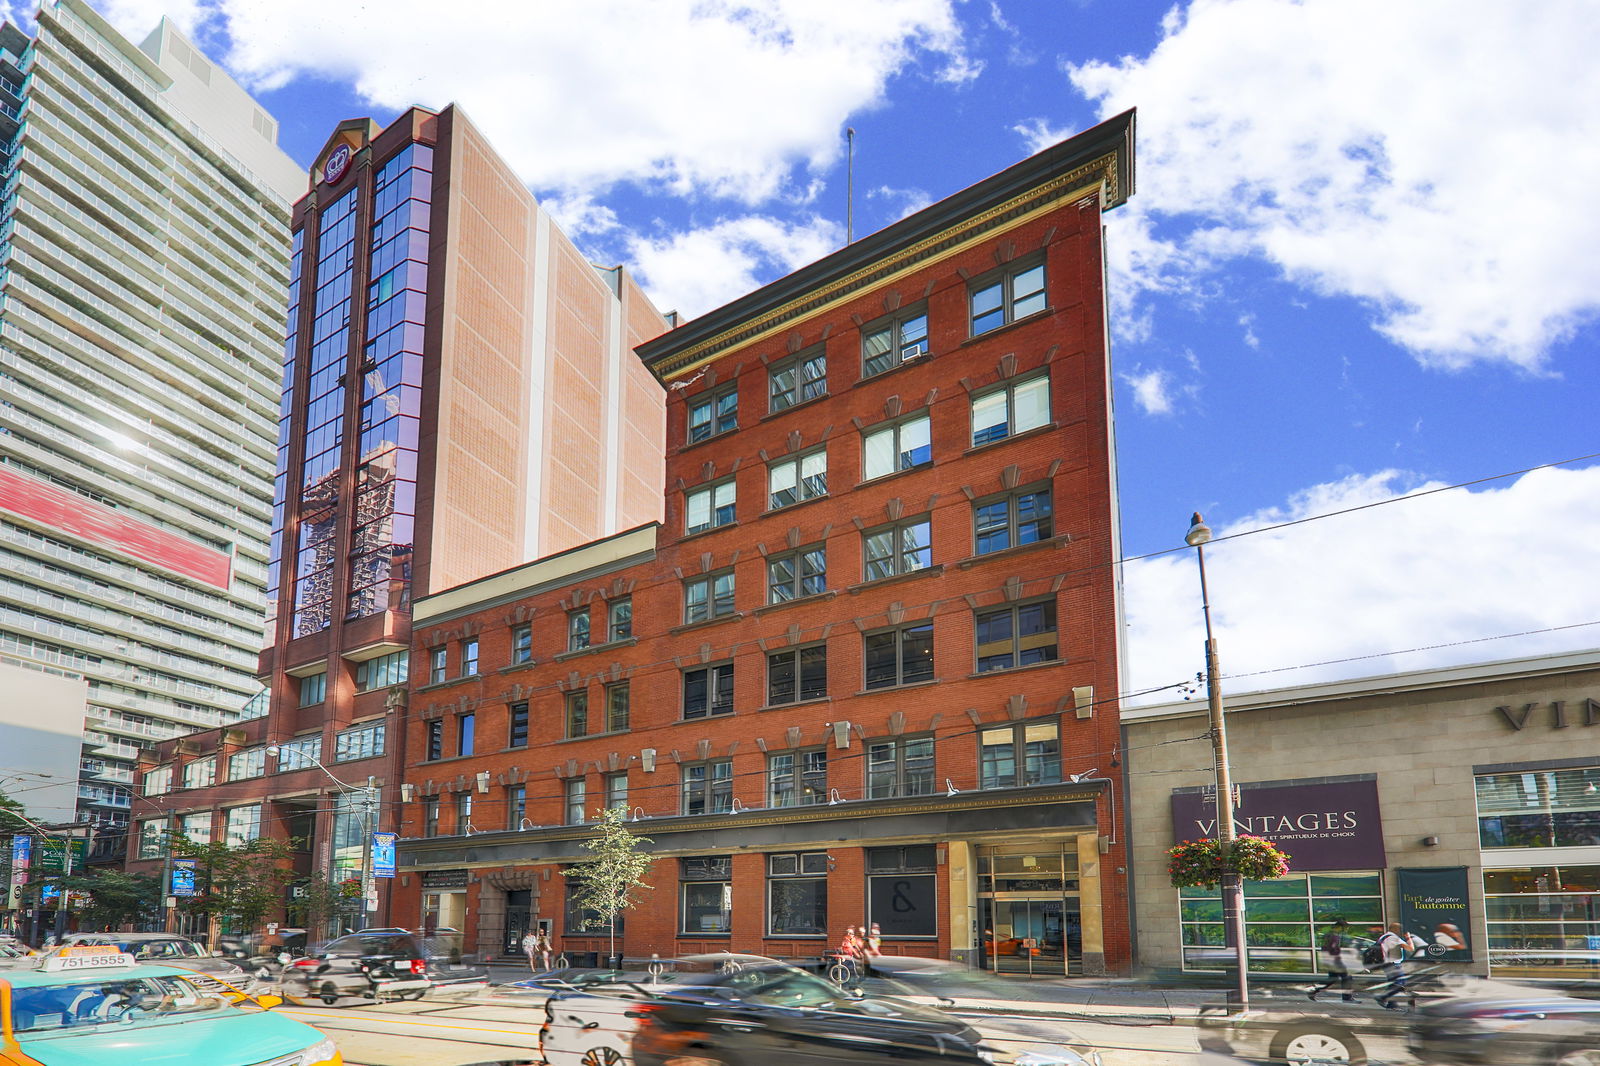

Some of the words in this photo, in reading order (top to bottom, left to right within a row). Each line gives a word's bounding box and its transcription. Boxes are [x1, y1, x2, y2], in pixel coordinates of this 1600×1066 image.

[1195, 811, 1357, 836] VNTAGES
[1435, 896, 1460, 904] goûter
[1414, 901, 1466, 910] l'automne
[61, 955, 125, 967] 751-5555
